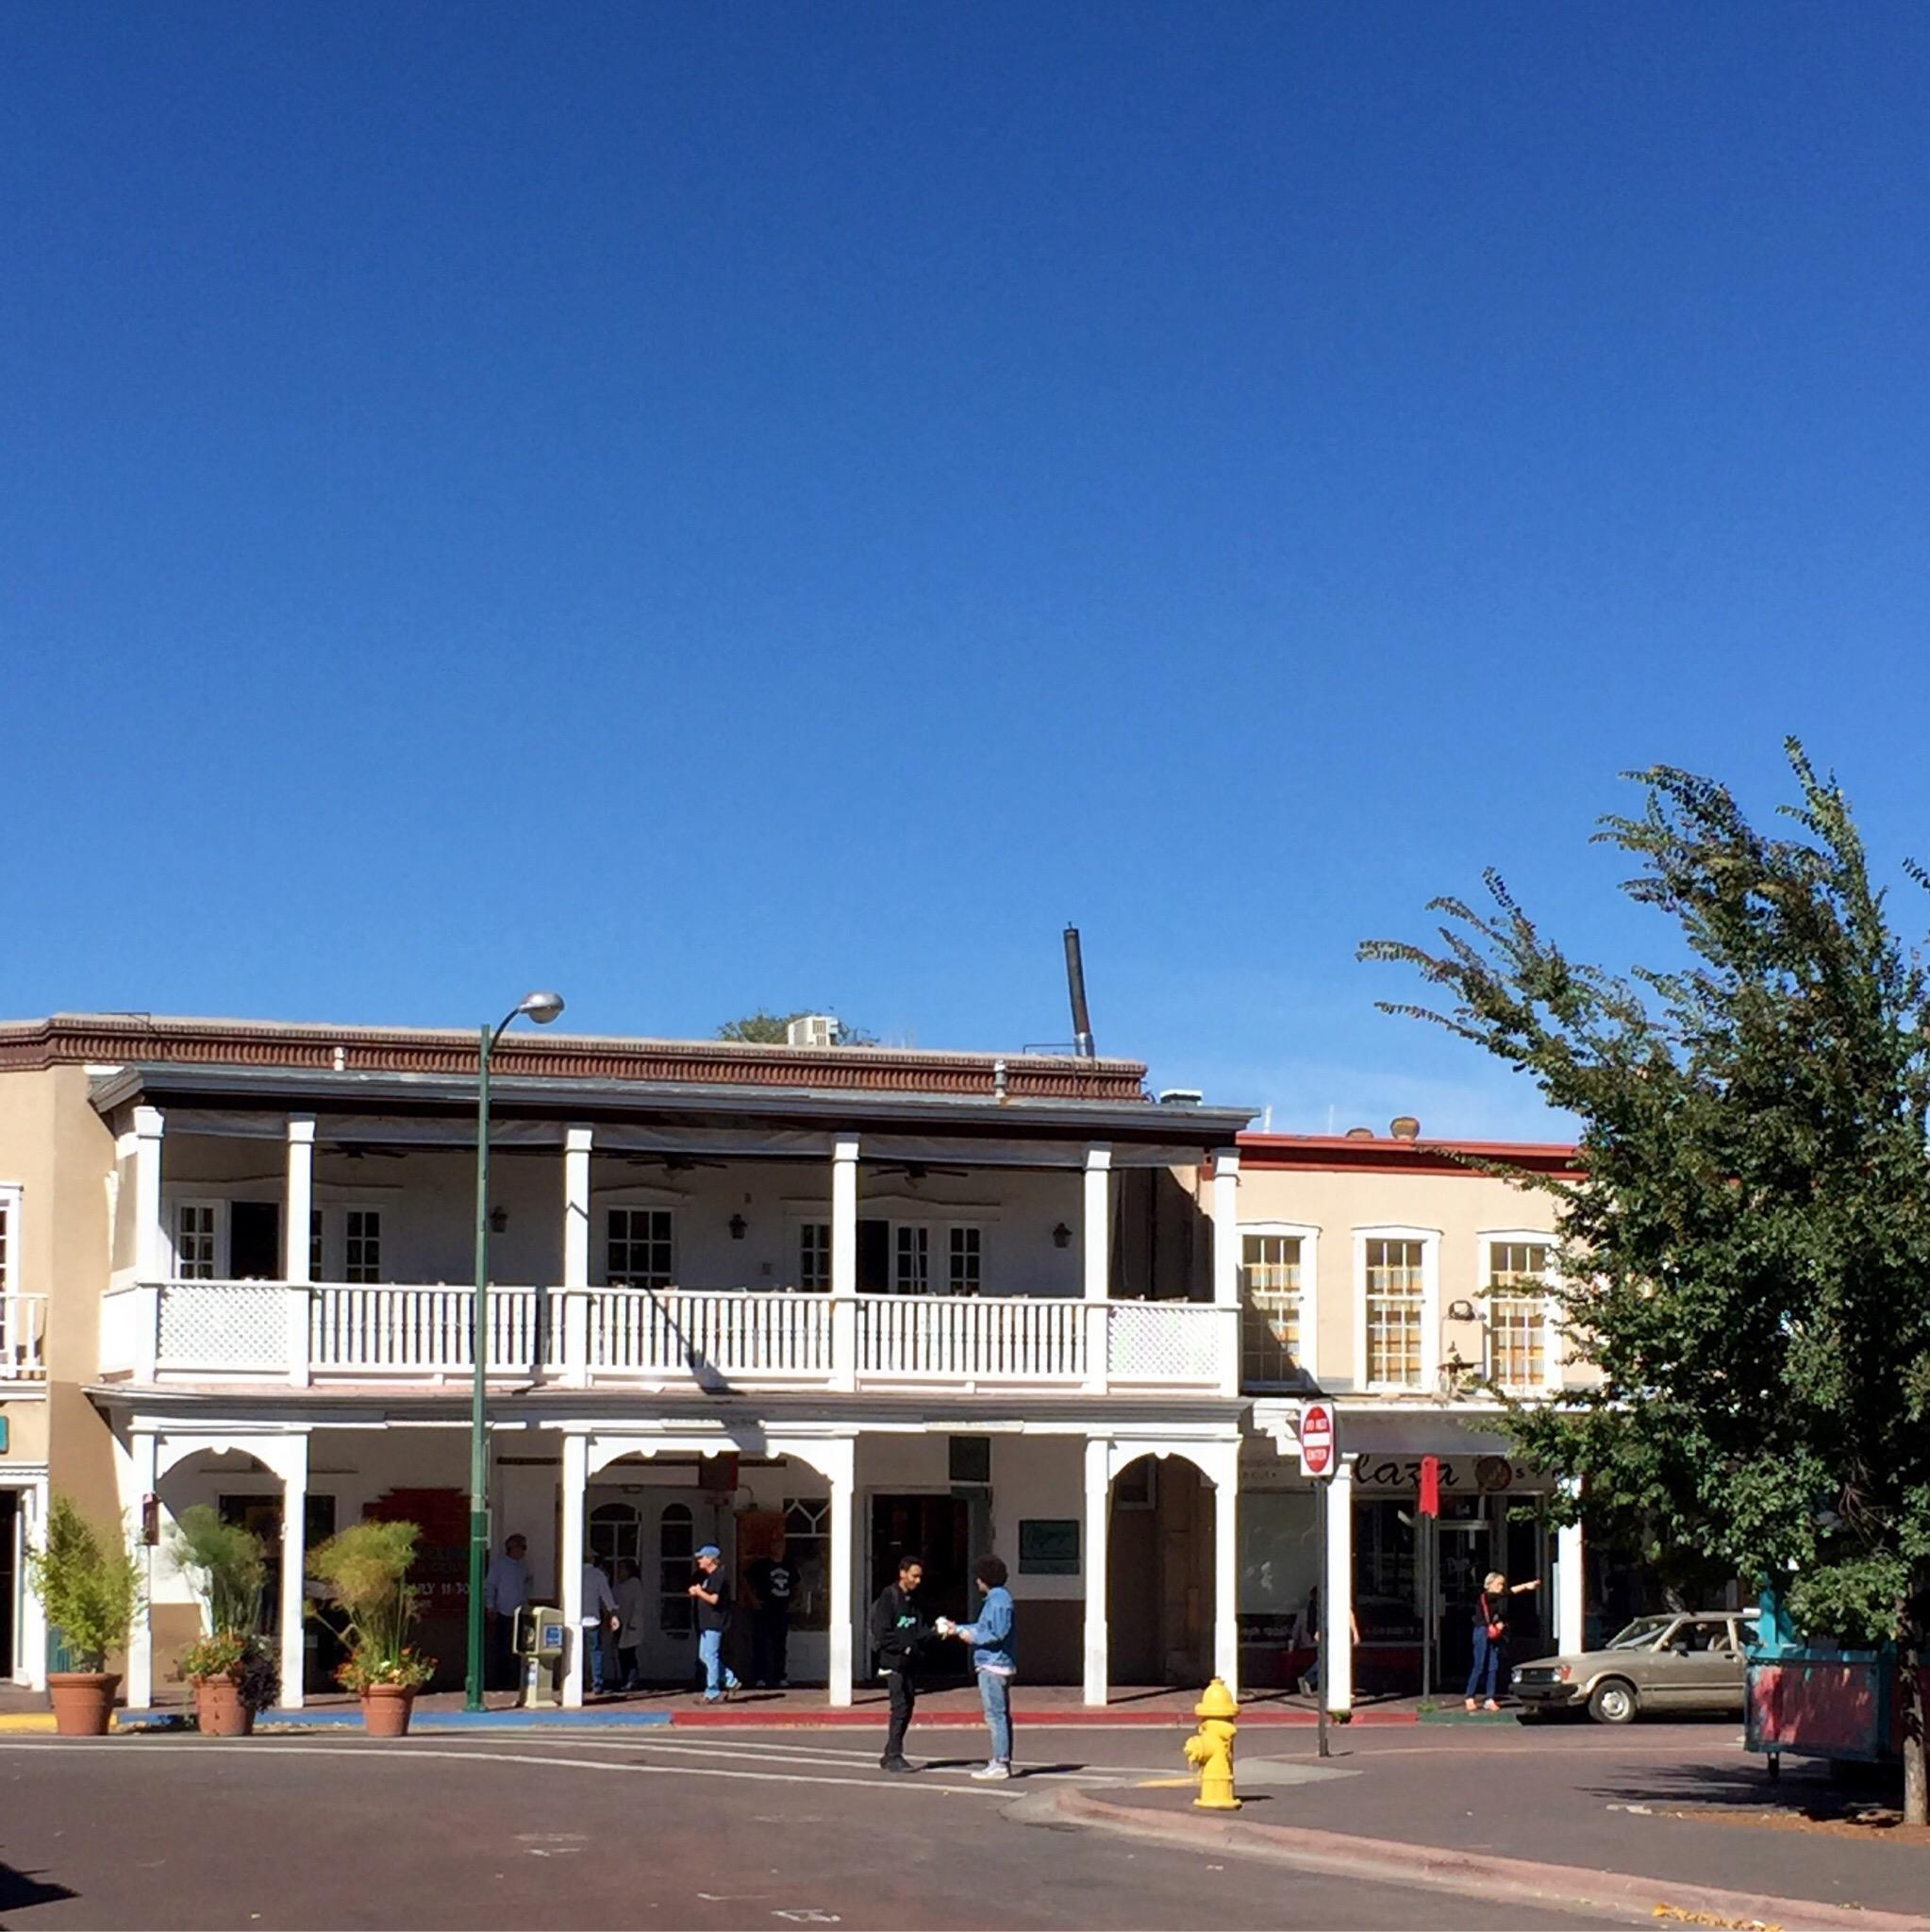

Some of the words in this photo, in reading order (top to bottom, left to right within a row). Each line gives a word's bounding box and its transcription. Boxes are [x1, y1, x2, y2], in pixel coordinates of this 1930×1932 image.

[1306, 1419, 1315, 1431] DO
[1316, 1418, 1328, 1430] NOT
[1306, 1448, 1327, 1462] ENTER
[1353, 1454, 1460, 1487] laza
